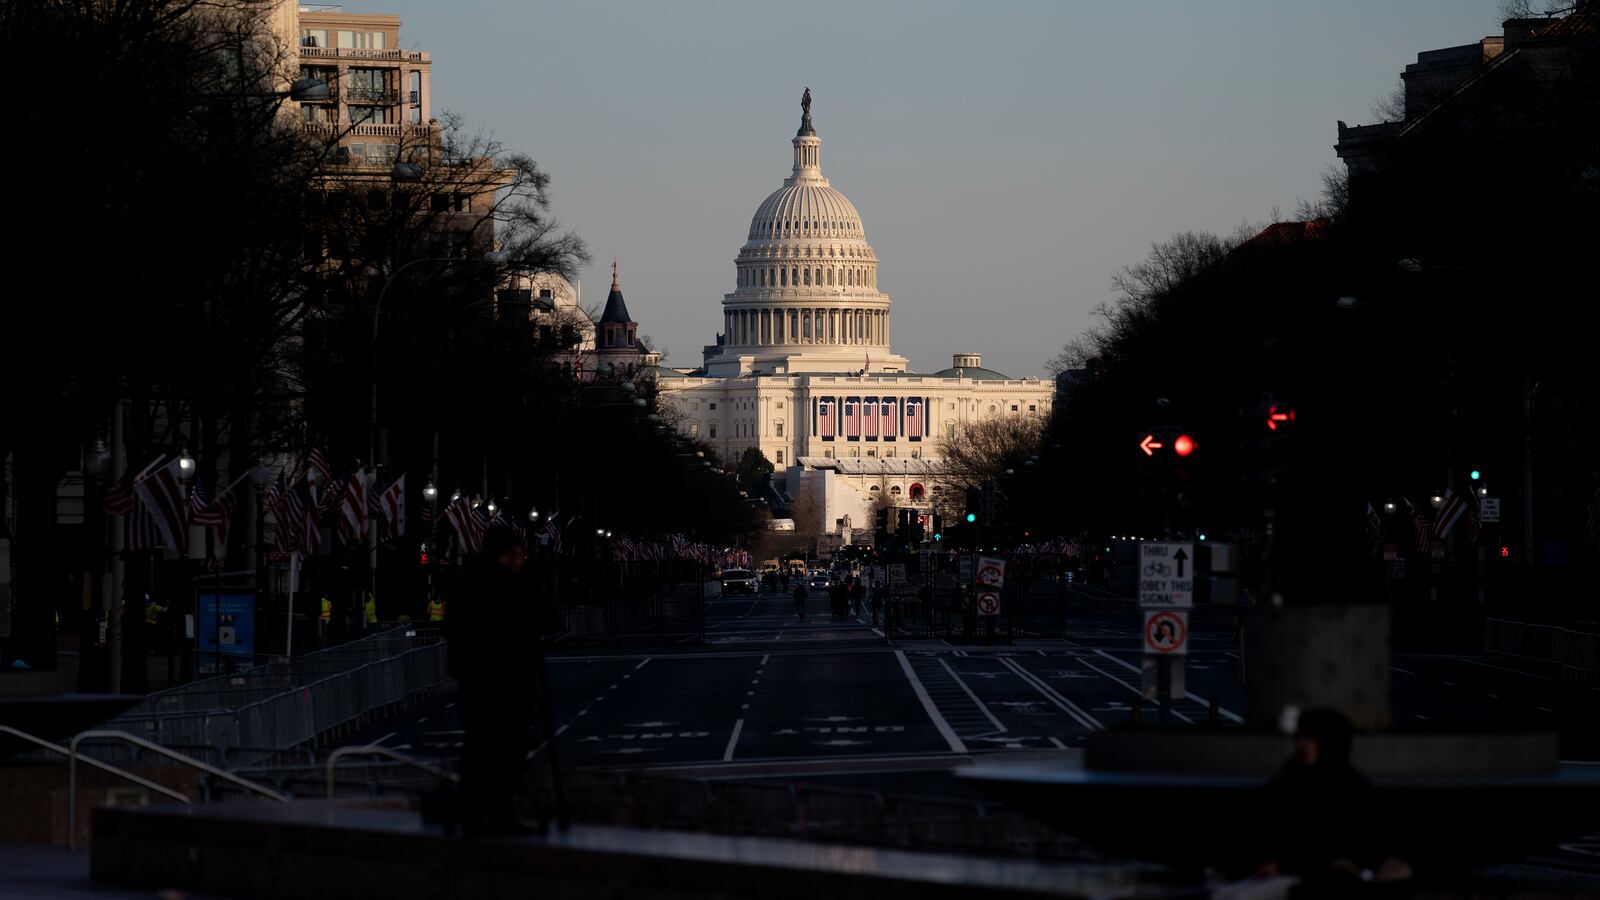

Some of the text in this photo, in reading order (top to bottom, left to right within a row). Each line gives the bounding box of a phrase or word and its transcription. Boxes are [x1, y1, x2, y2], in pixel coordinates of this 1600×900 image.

[1143, 546, 1168, 557] THRU
[1142, 581, 1193, 592] OBEY THIS
[1142, 593, 1174, 604] SIGNAL
